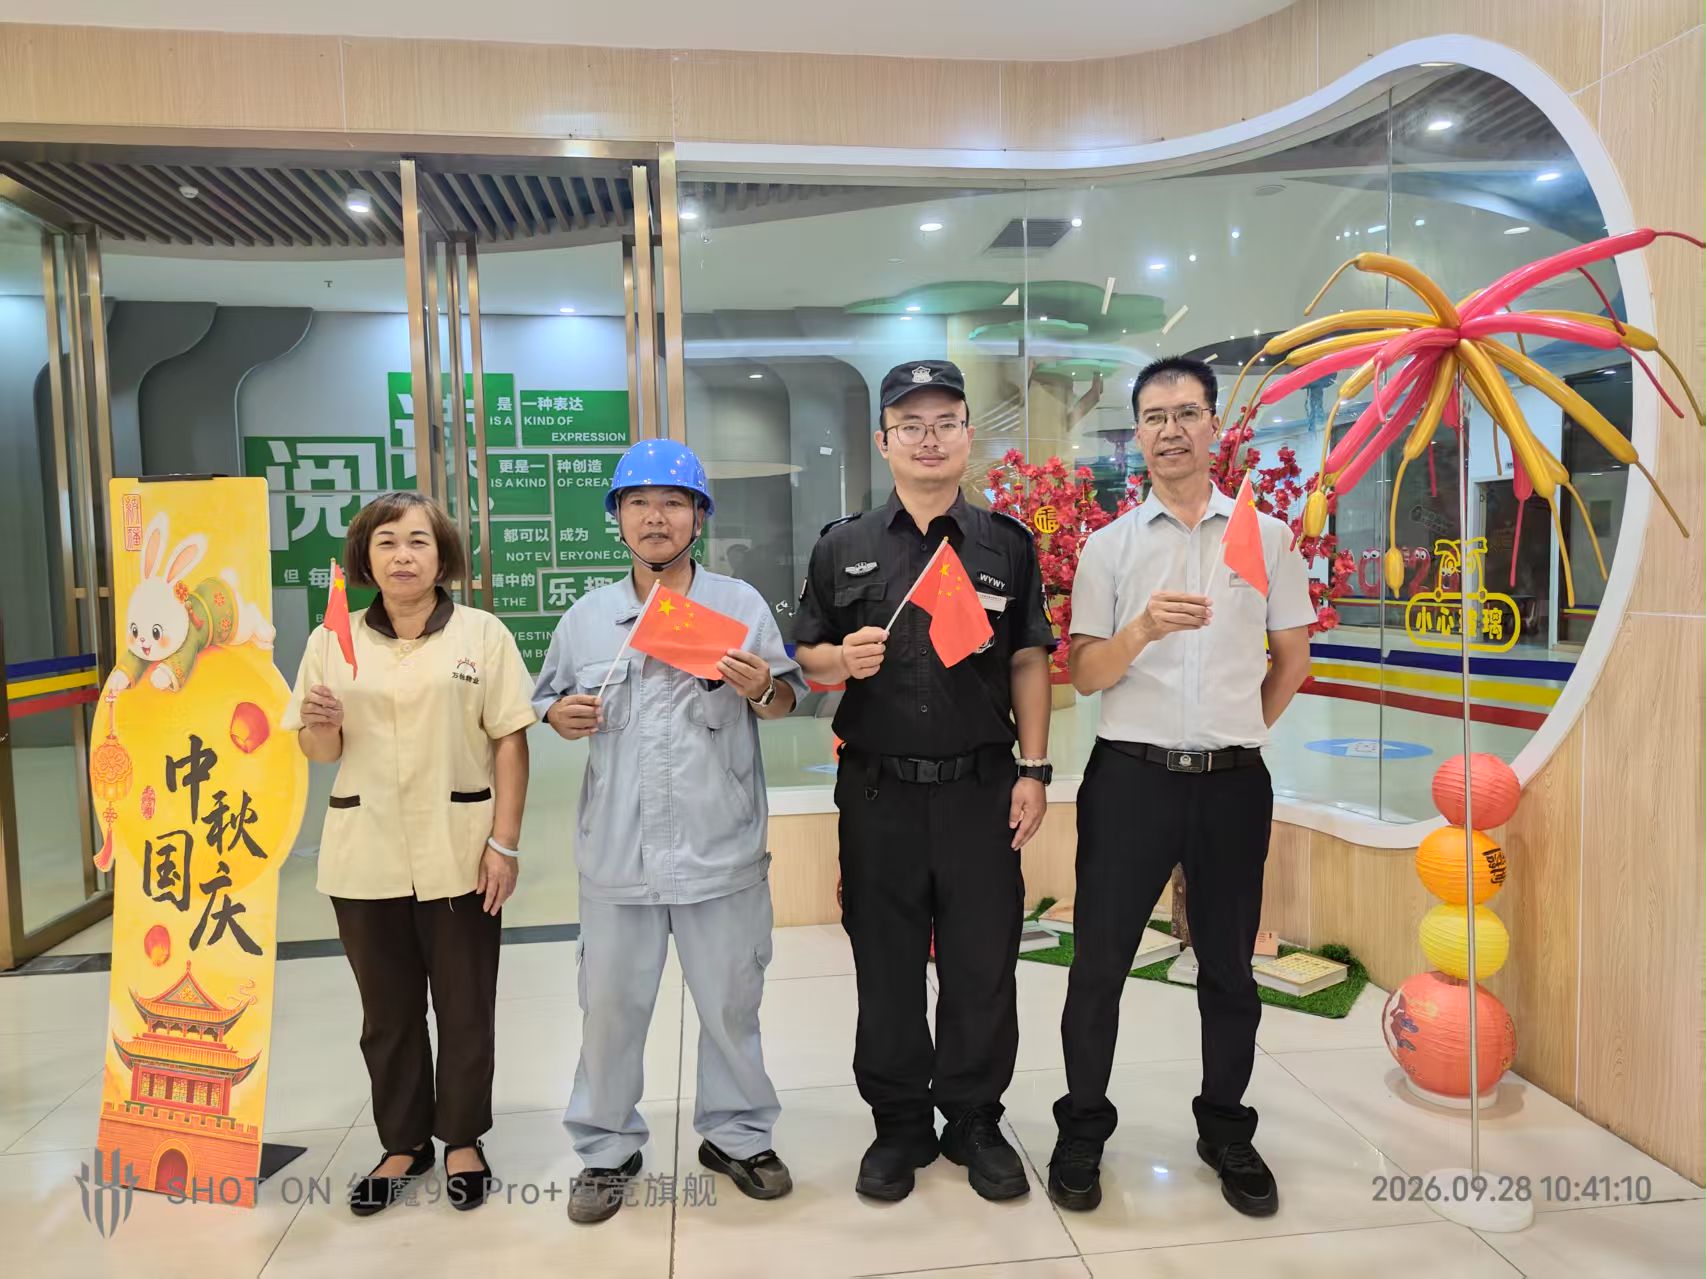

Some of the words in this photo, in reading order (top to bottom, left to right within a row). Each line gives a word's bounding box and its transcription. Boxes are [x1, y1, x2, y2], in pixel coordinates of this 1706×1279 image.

[497, 396, 513, 411] 是
[522, 396, 584, 411] 一种表达
[489, 416, 502, 426] IS
[504, 416, 513, 426] A
[523, 416, 555, 426] KIND
[557, 416, 574, 425] OF
[551, 432, 626, 442] EXPRESSION
[498, 459, 545, 474] 更是一
[557, 459, 603, 474] 种创造
[490, 478, 502, 488] IS
[504, 478, 514, 488] A
[516, 478, 546, 488] KIND
[557, 477, 573, 487] OF
[1034, 505, 1061, 534] 福
[503, 528, 549, 543] 都可以
[559, 528, 589, 542] 成为
[506, 552, 534, 562] NOT
[284, 568, 300, 583] 但
[980, 573, 1006, 590] WYWY
[502, 597, 527, 607] THE
